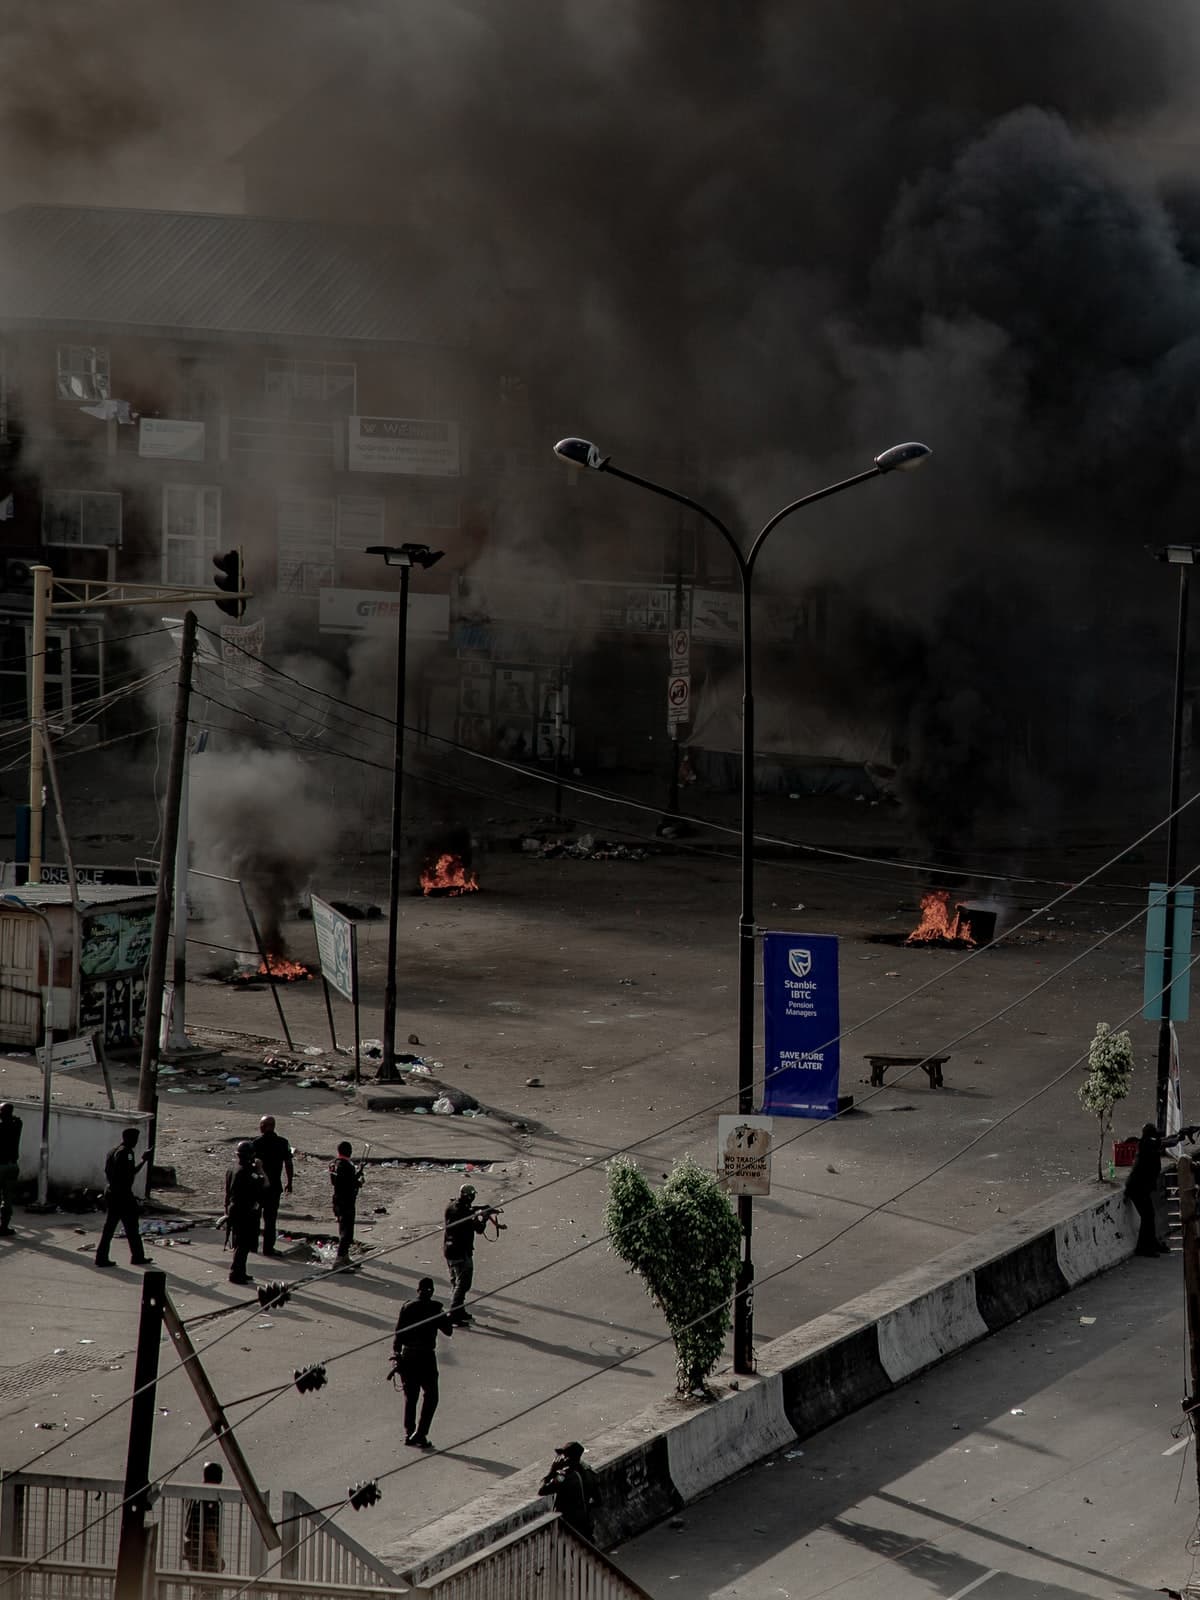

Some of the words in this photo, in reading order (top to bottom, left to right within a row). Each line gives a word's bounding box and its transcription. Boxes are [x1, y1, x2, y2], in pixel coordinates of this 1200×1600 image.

[784, 979, 817, 990] Stanbic
[791, 990, 812, 1000] IBTC
[788, 1000, 814, 1009] Pension
[785, 1008, 818, 1018] Managers
[779, 1051, 800, 1060] SAVE
[801, 1052, 824, 1061] MORE
[781, 1060, 798, 1070] FOR
[798, 1061, 823, 1071] LATER
